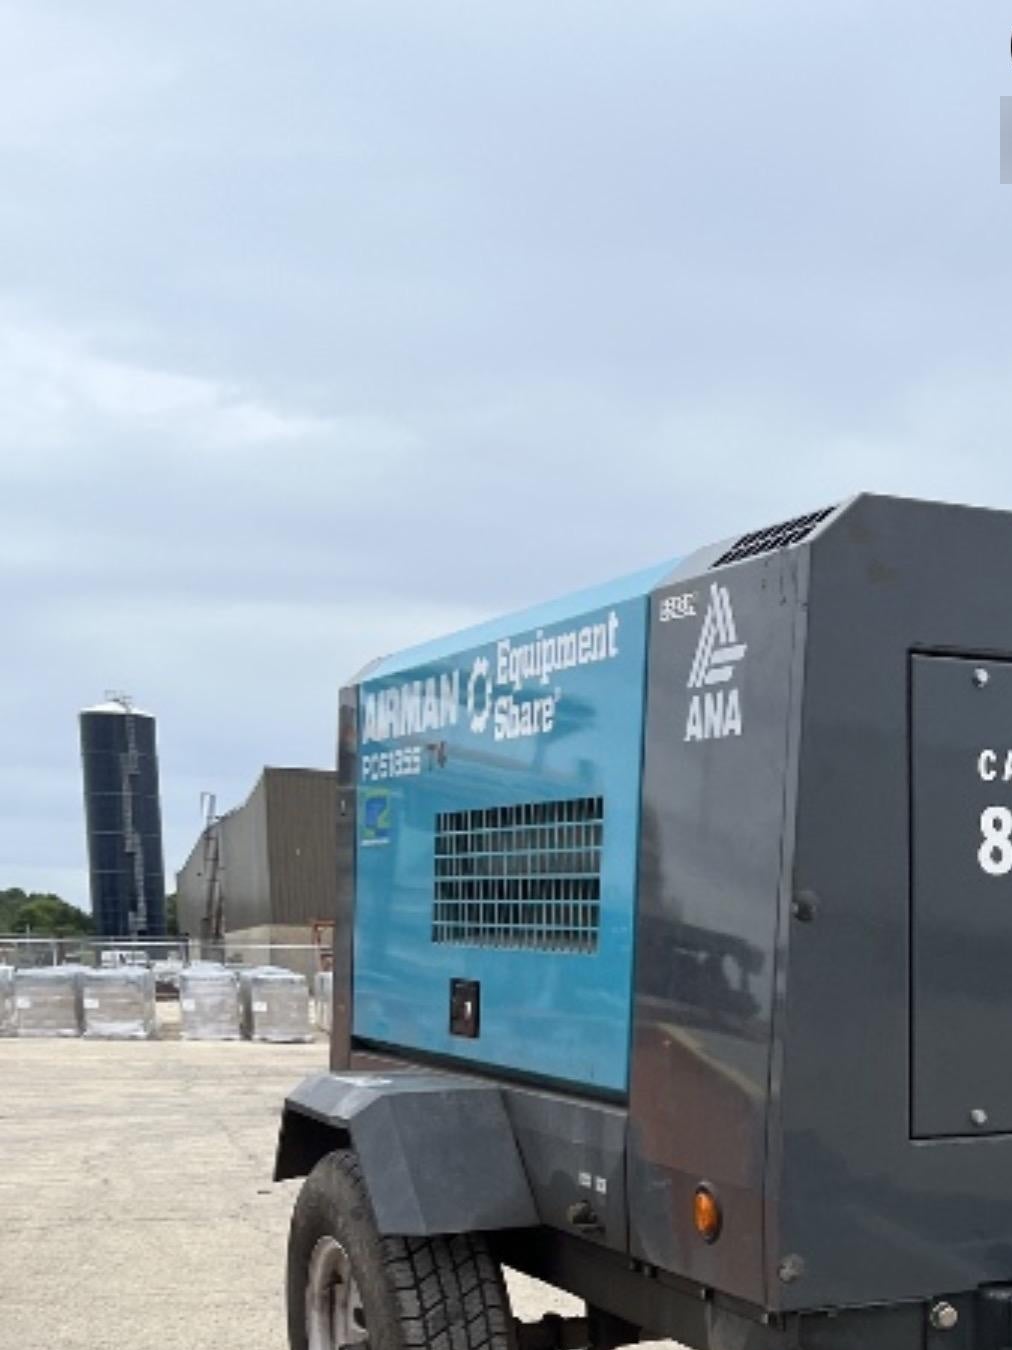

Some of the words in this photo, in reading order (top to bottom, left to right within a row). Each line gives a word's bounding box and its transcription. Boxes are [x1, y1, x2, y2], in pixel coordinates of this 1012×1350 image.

[496, 611, 619, 690] Equipment
[361, 669, 460, 744] AIRMAN
[494, 695, 554, 741] Share
[684, 688, 743, 742] ANA
